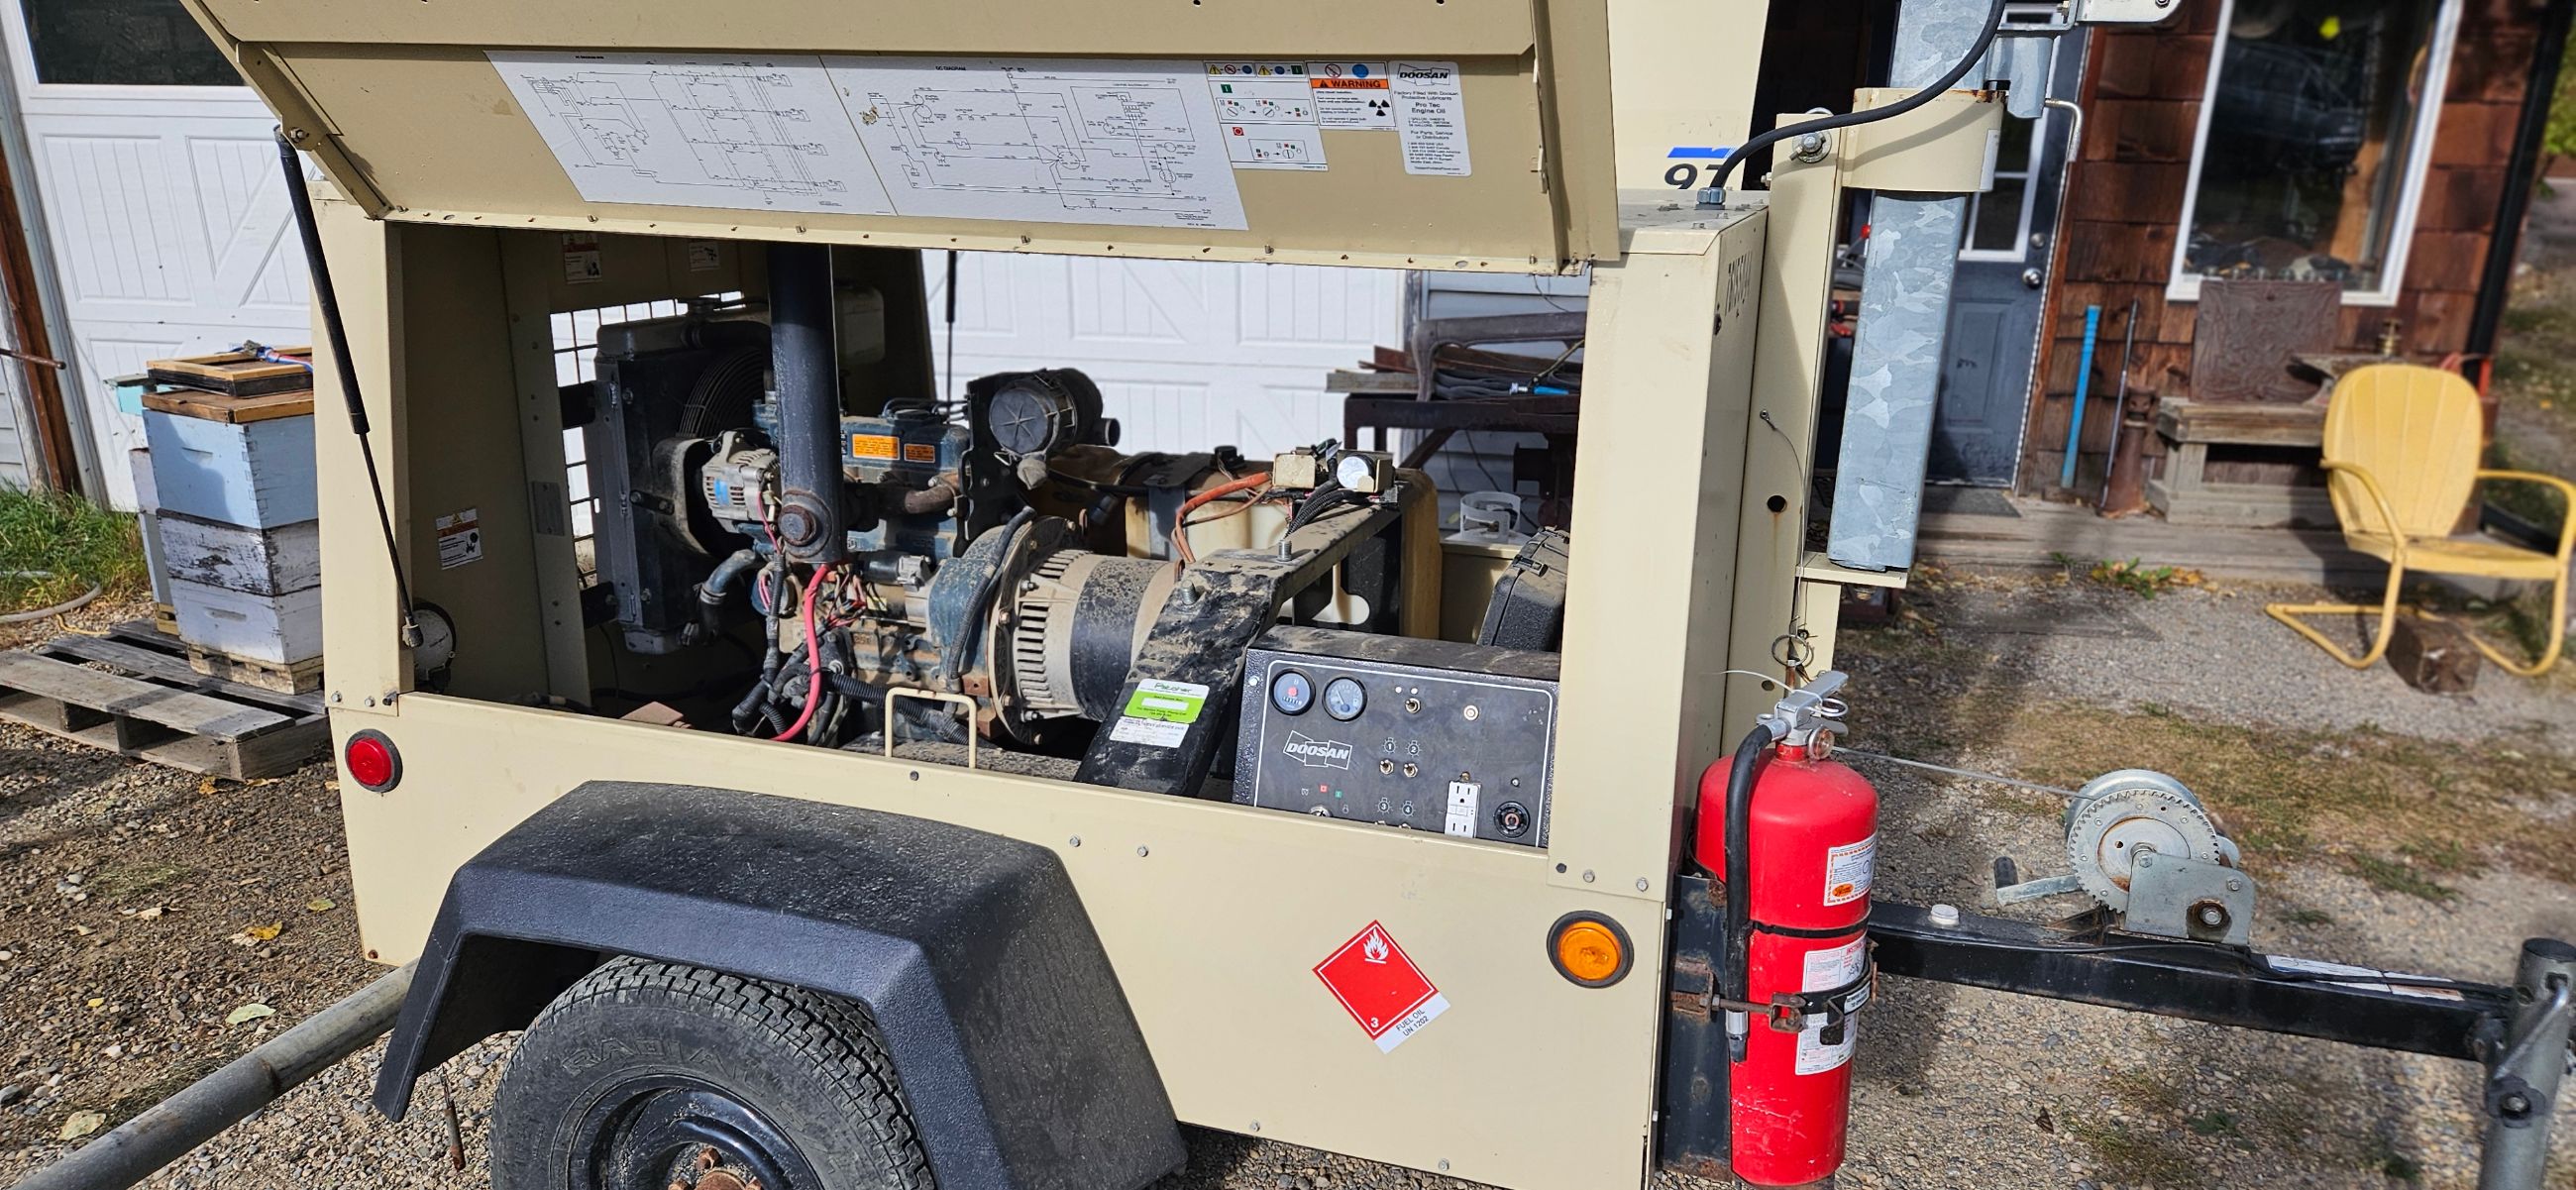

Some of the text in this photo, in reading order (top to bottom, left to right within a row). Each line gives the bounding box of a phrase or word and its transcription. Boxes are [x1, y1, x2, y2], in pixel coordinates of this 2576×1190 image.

[1331, 79, 1381, 88] WARNING
[1286, 742, 1349, 760] DOOSAN
[1370, 1017, 1379, 1028] 3
[1396, 1009, 1426, 1031] FUEL OIL
[1403, 1016, 1430, 1036] UN 1202
